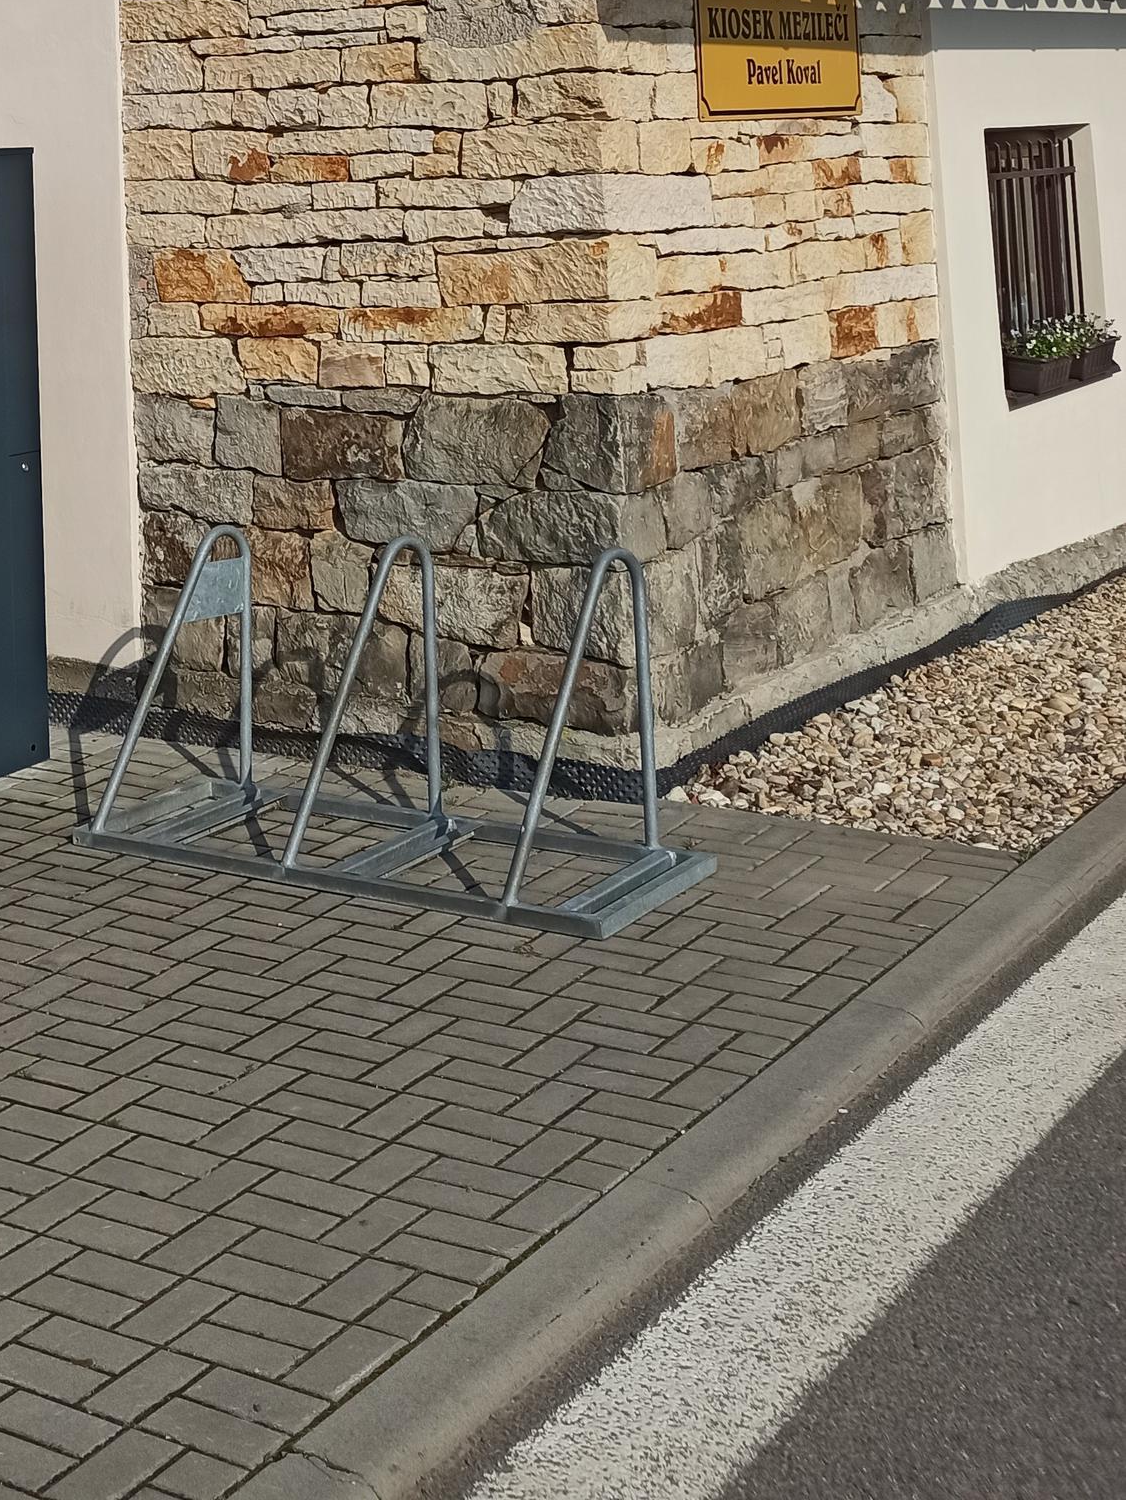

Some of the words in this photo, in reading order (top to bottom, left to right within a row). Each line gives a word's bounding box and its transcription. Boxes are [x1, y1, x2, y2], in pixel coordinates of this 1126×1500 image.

[707, 7, 775, 40] KIOSEK
[779, 4, 850, 42] MEZILEČÍ
[746, 58, 784, 85] Pavel
[786, 58, 822, 85] Koval
